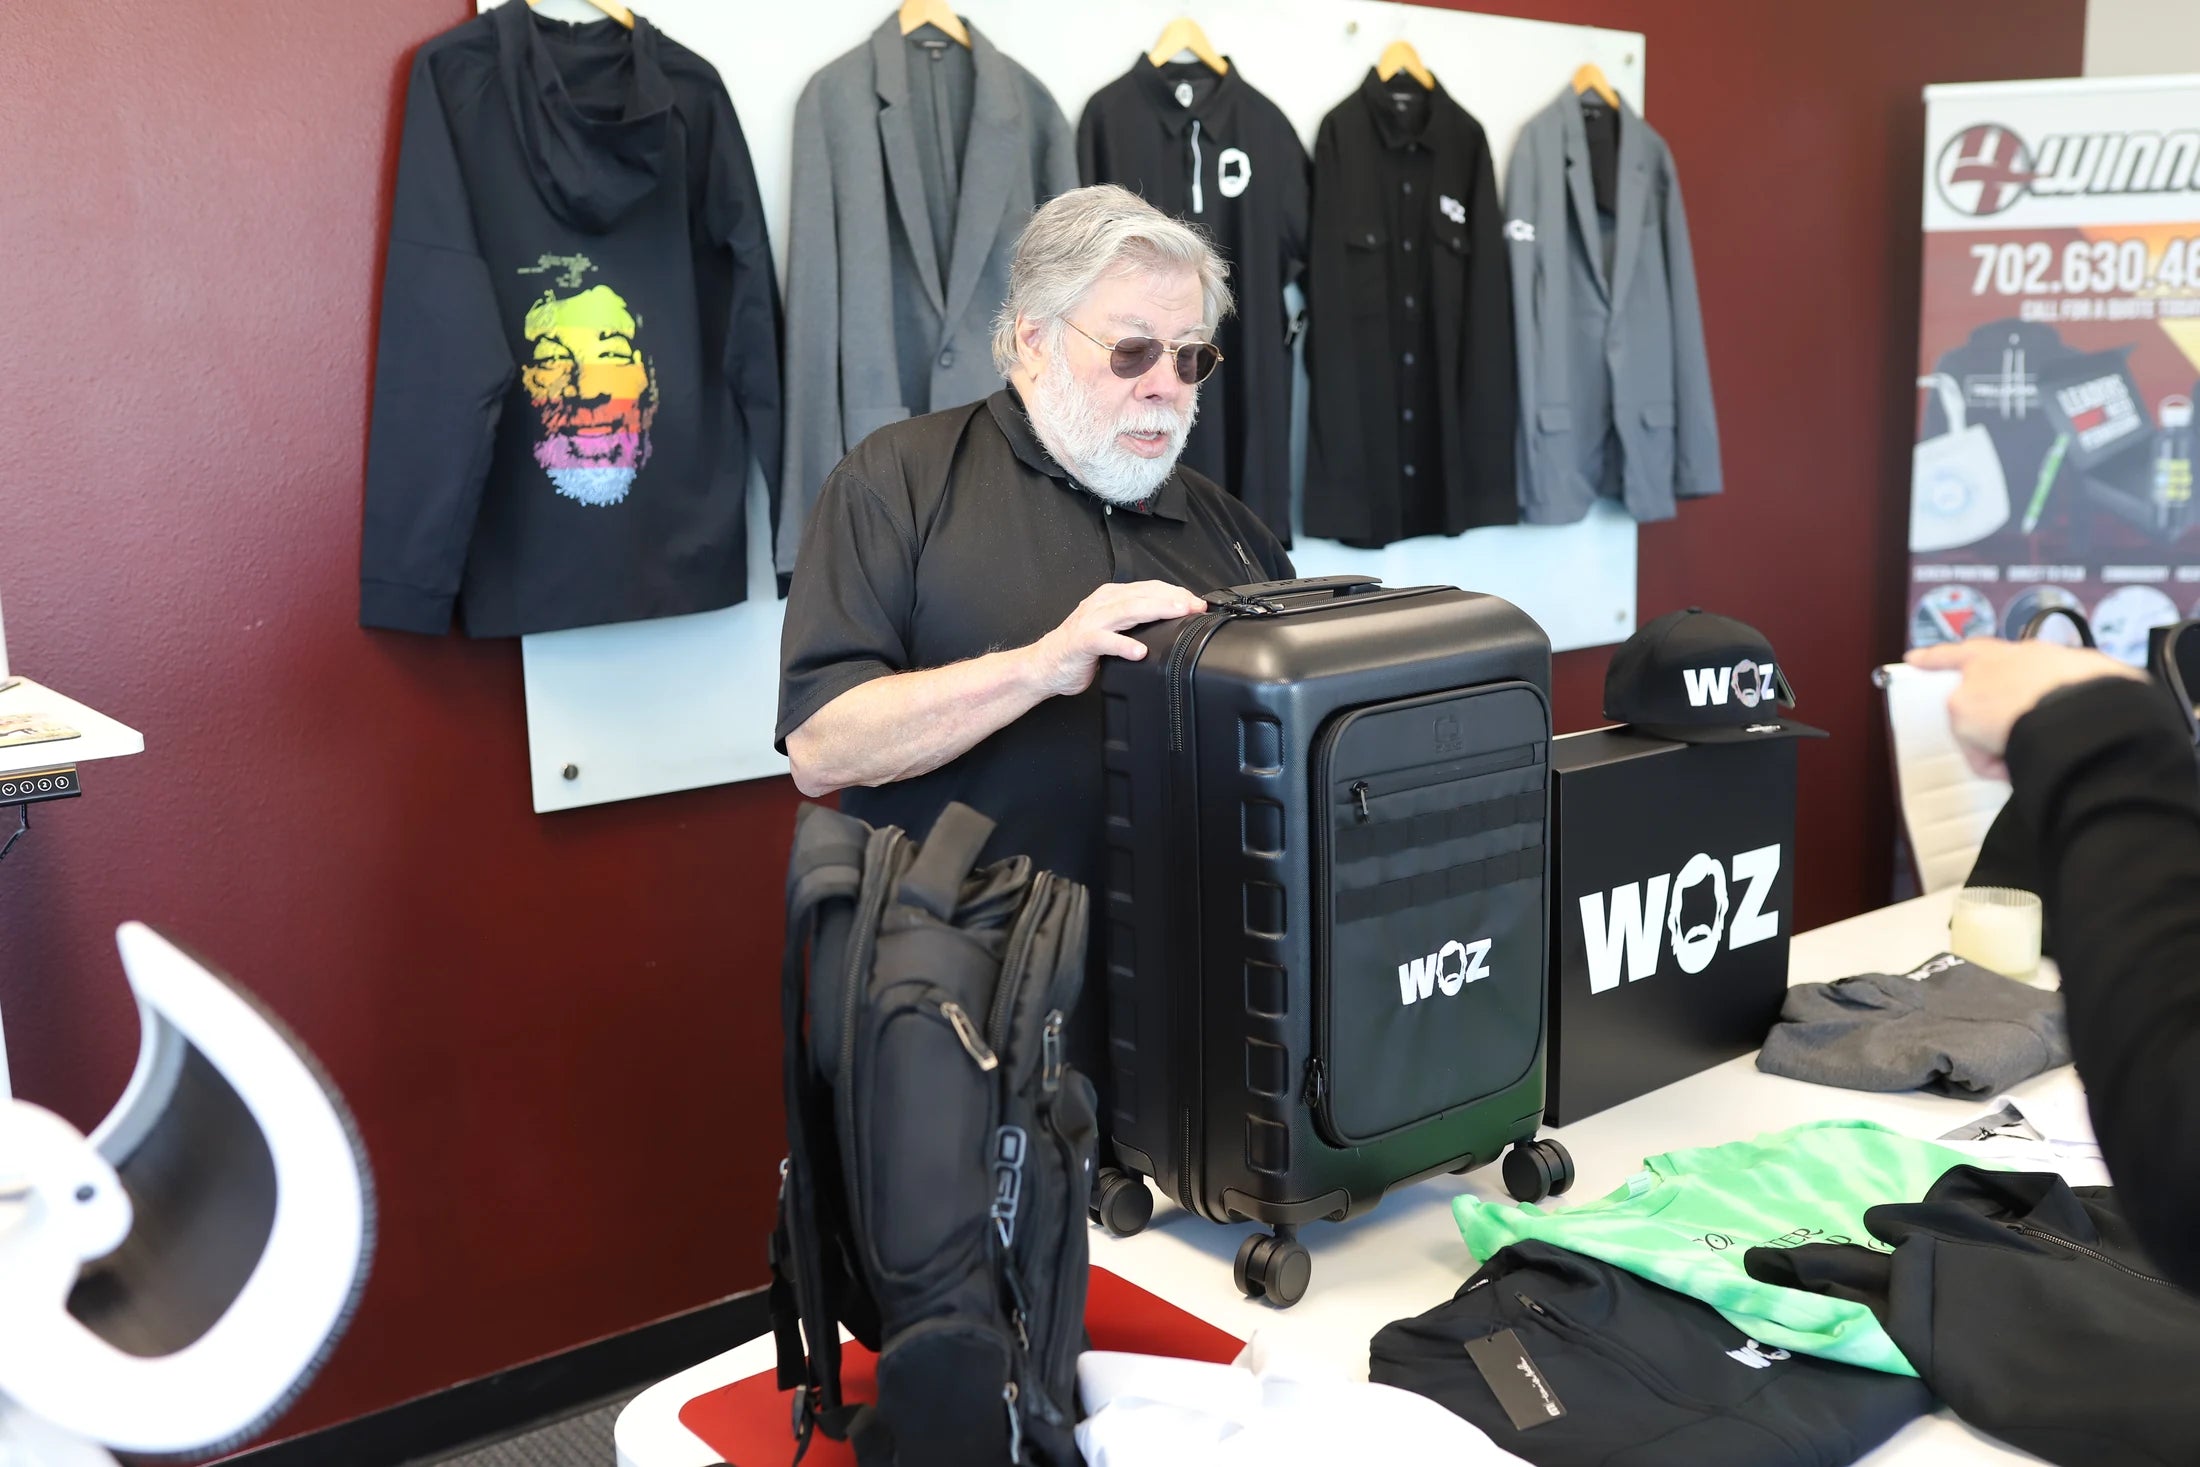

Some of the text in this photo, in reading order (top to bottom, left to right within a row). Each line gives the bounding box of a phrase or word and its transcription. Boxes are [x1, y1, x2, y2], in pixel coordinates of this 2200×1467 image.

[2029, 129, 2200, 197] WINN
[1683, 659, 1775, 708] WOZ
[1579, 843, 1781, 995] WOZ
[1398, 938, 1492, 1005] WOZ
